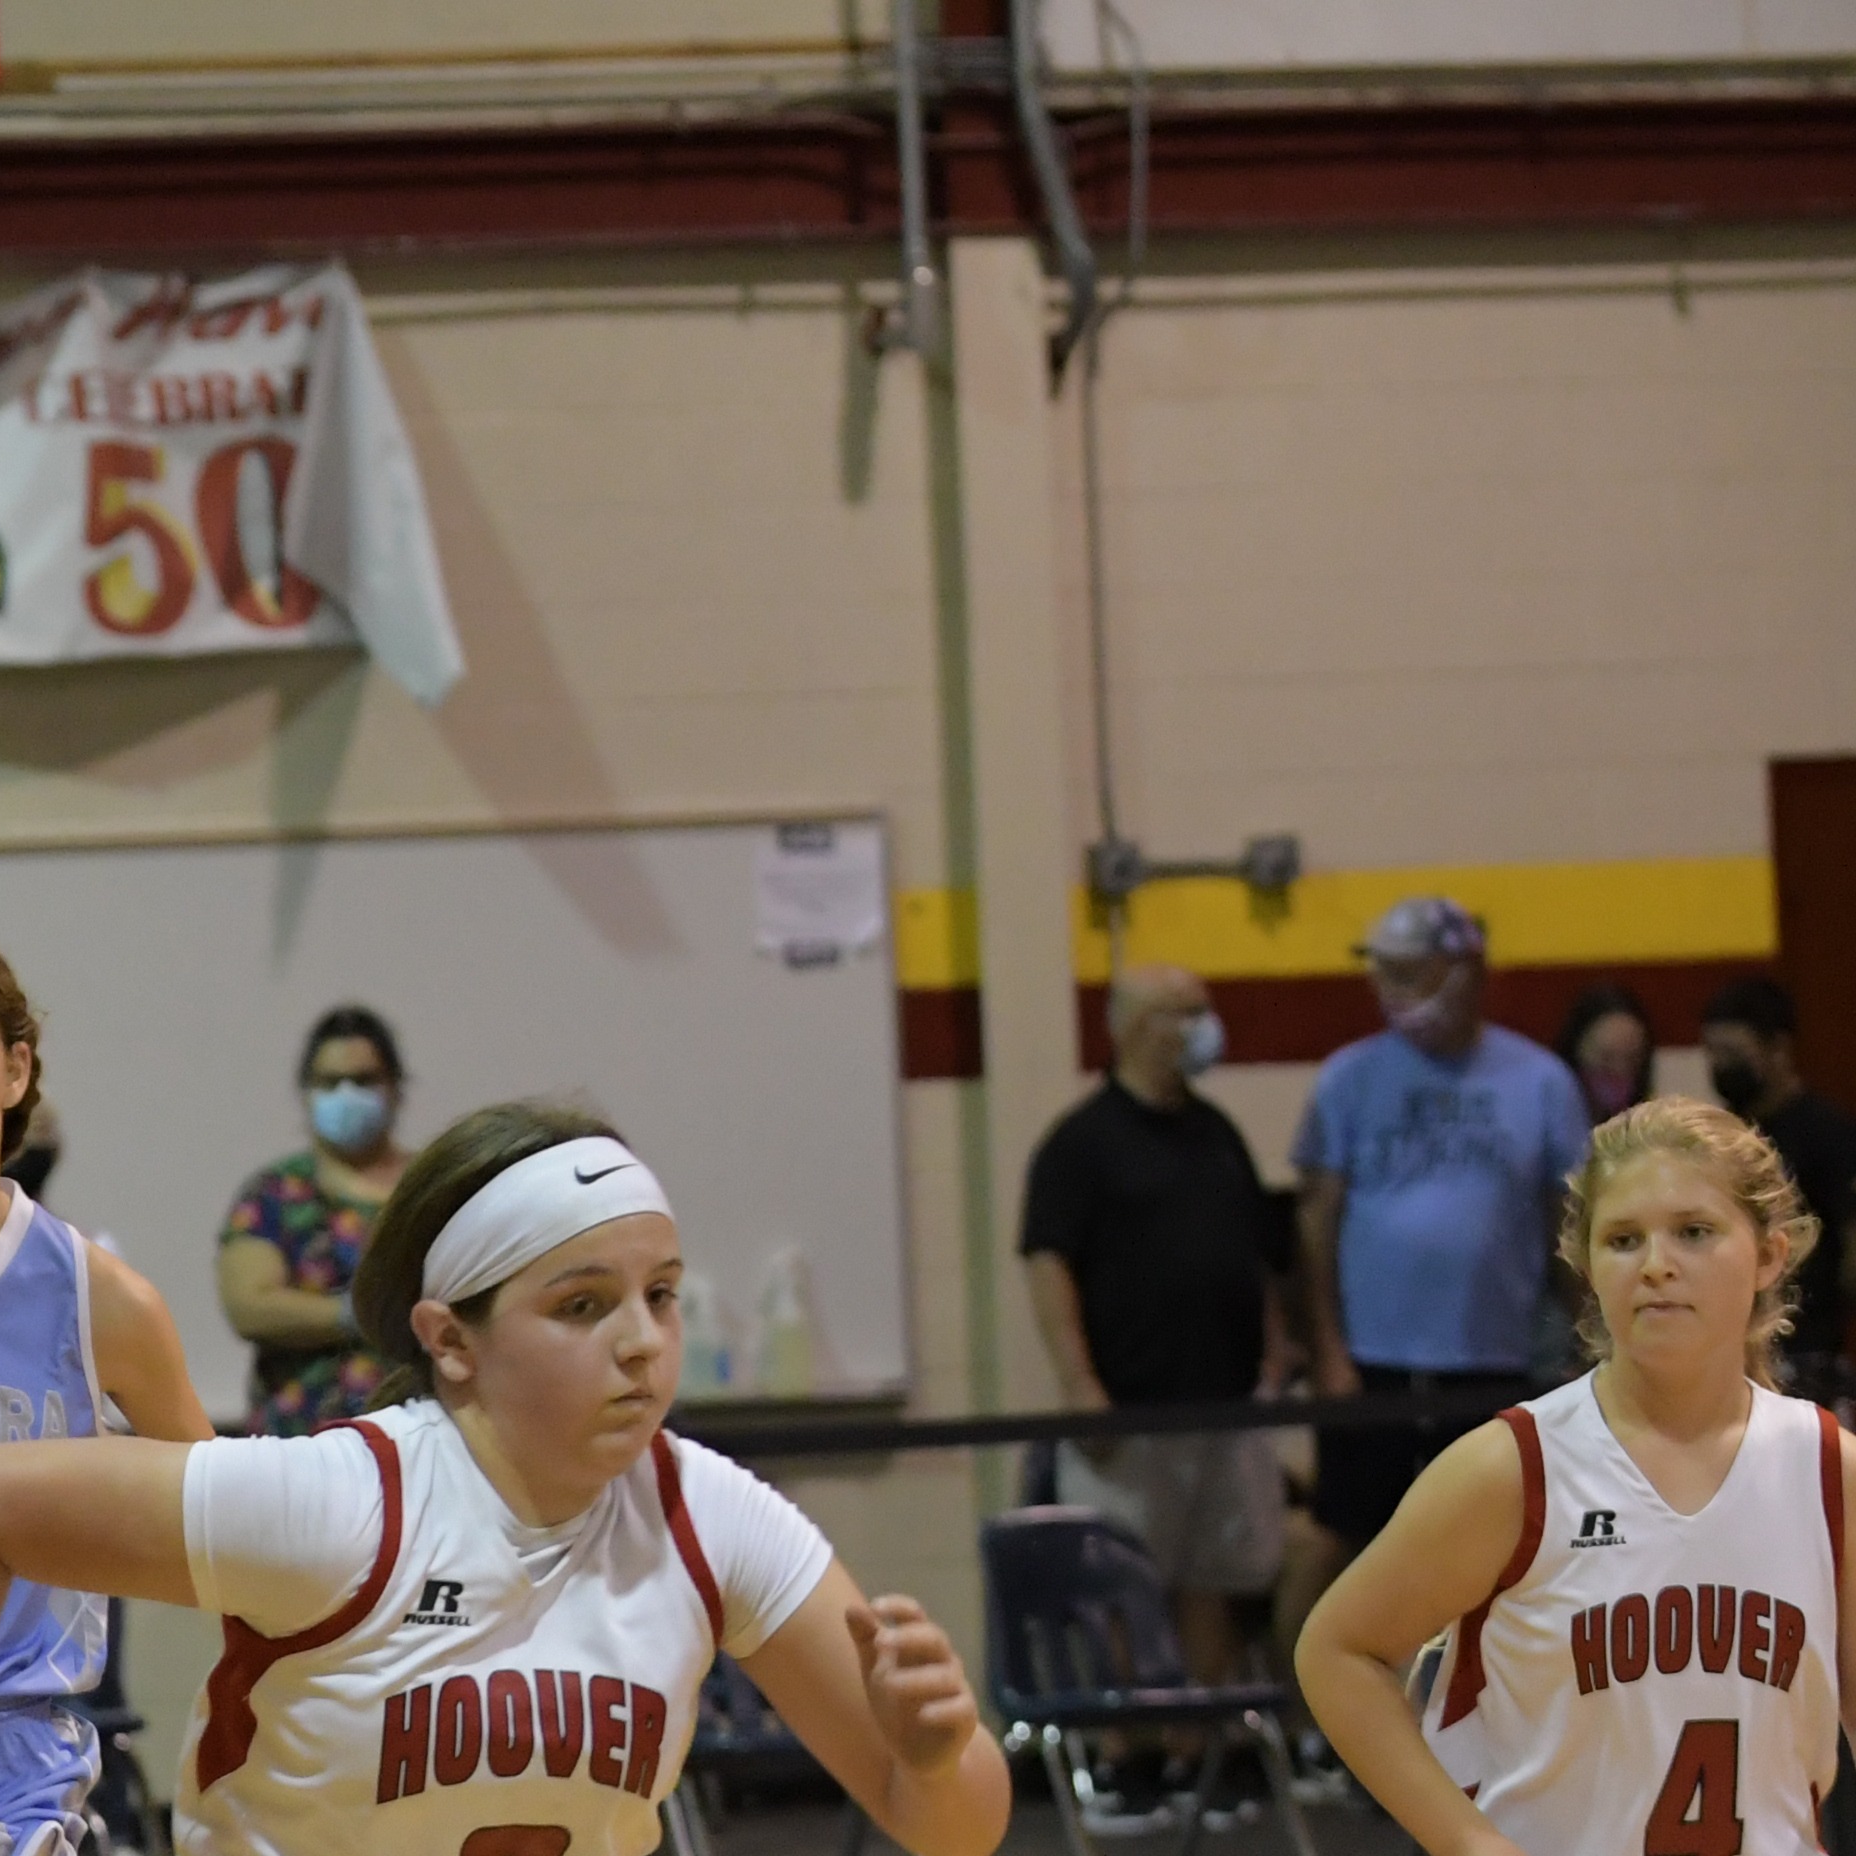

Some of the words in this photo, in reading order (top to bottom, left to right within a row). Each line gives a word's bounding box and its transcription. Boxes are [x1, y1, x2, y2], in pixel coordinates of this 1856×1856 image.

[402, 1613, 471, 1627] RUSSELL
[1570, 1583, 1807, 1697] HOOVER
[376, 1668, 668, 1805] HOOVER
